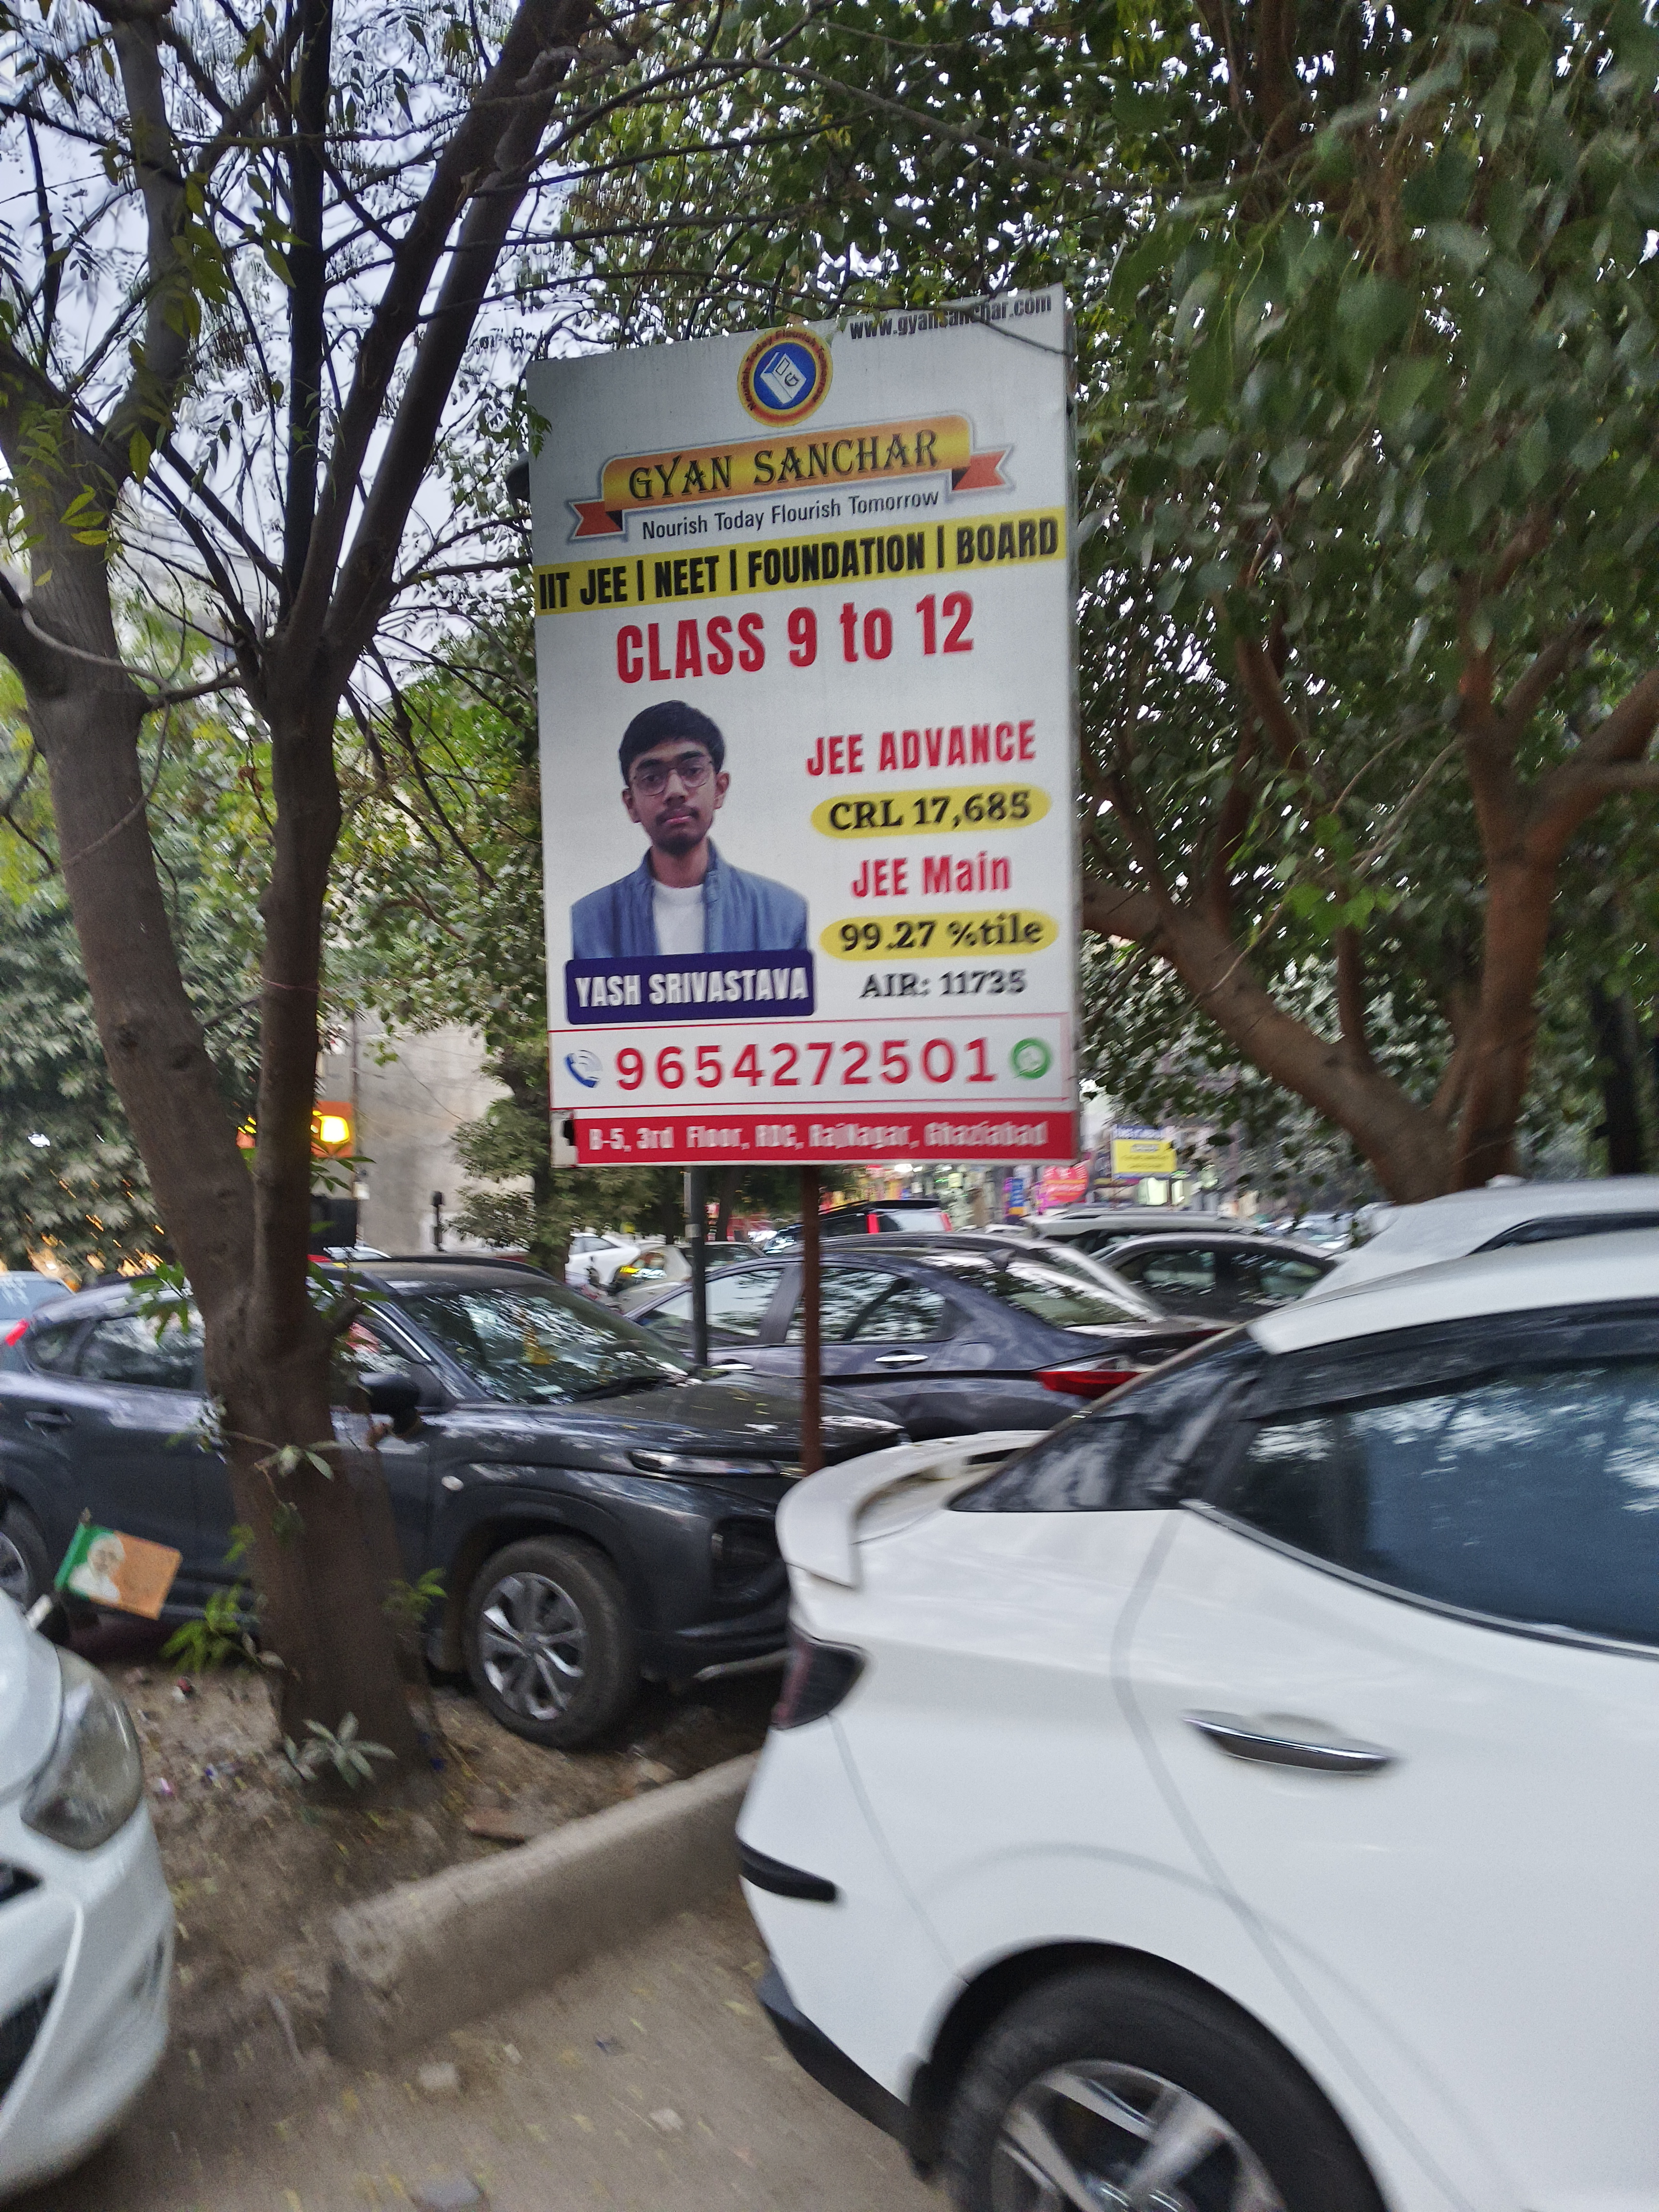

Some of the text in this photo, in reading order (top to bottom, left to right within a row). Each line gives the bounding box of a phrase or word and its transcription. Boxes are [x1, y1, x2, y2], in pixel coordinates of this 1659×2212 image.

[629, 429, 938, 500] GYAN SANCHAR
[642, 491, 939, 539] Nourish Today Flourish Tomorrow
[539, 571, 570, 610] IIT
[580, 566, 627, 605] JEE
[654, 555, 720, 598] NEET
[748, 531, 925, 588] FOUNDATION
[957, 517, 1058, 565] BOARD
[616, 590, 974, 683] CLASS 9 to 12
[806, 719, 1036, 776] JEE ADVANCE
[829, 790, 1031, 831] CRL 17,685
[851, 851, 1012, 898] JEE Main
[840, 912, 1045, 951] 99.27 %tile
[575, 967, 809, 1008] YASH SRIVASTAVA
[859, 968, 1028, 999] AIR: 11735
[615, 1037, 996, 1091] 9654272501
[589, 1128, 632, 1152] B-5,
[636, 1126, 674, 1149] 3rd
